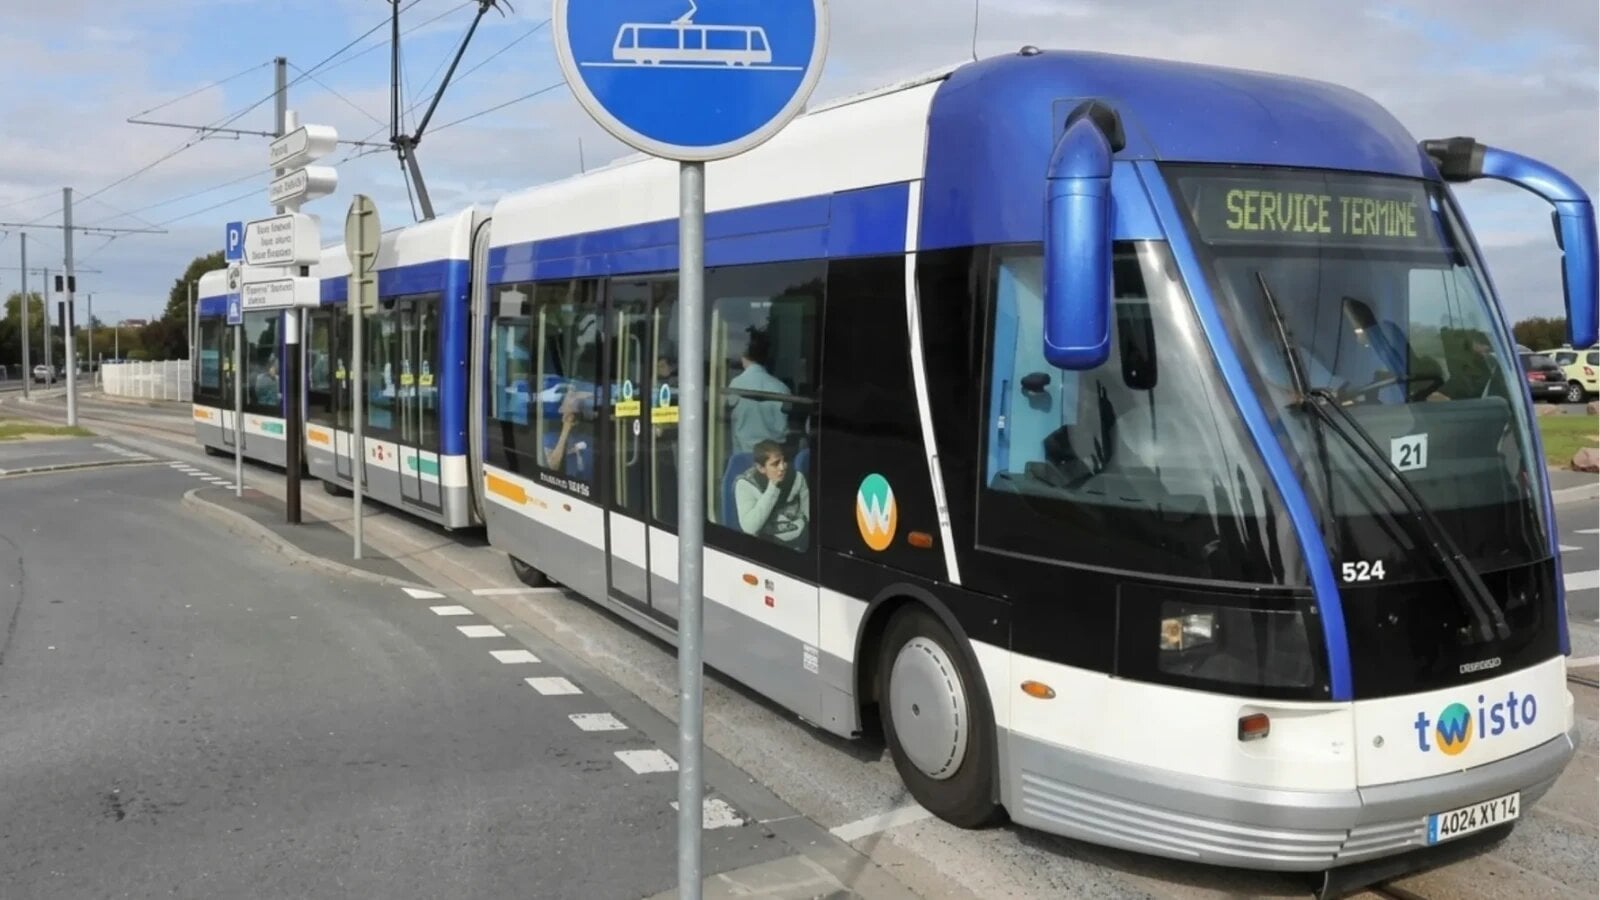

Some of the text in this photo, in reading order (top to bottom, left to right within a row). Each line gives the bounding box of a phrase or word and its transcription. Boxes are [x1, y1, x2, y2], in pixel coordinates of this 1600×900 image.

[1226, 189, 1417, 237] SERVICE TERMINÉ
[230, 229, 239, 251] P
[1399, 442, 1422, 467] 21
[1342, 560, 1386, 582] 524
[1414, 691, 1537, 753] twisto
[1440, 797, 1517, 835] 4024 XY 14
